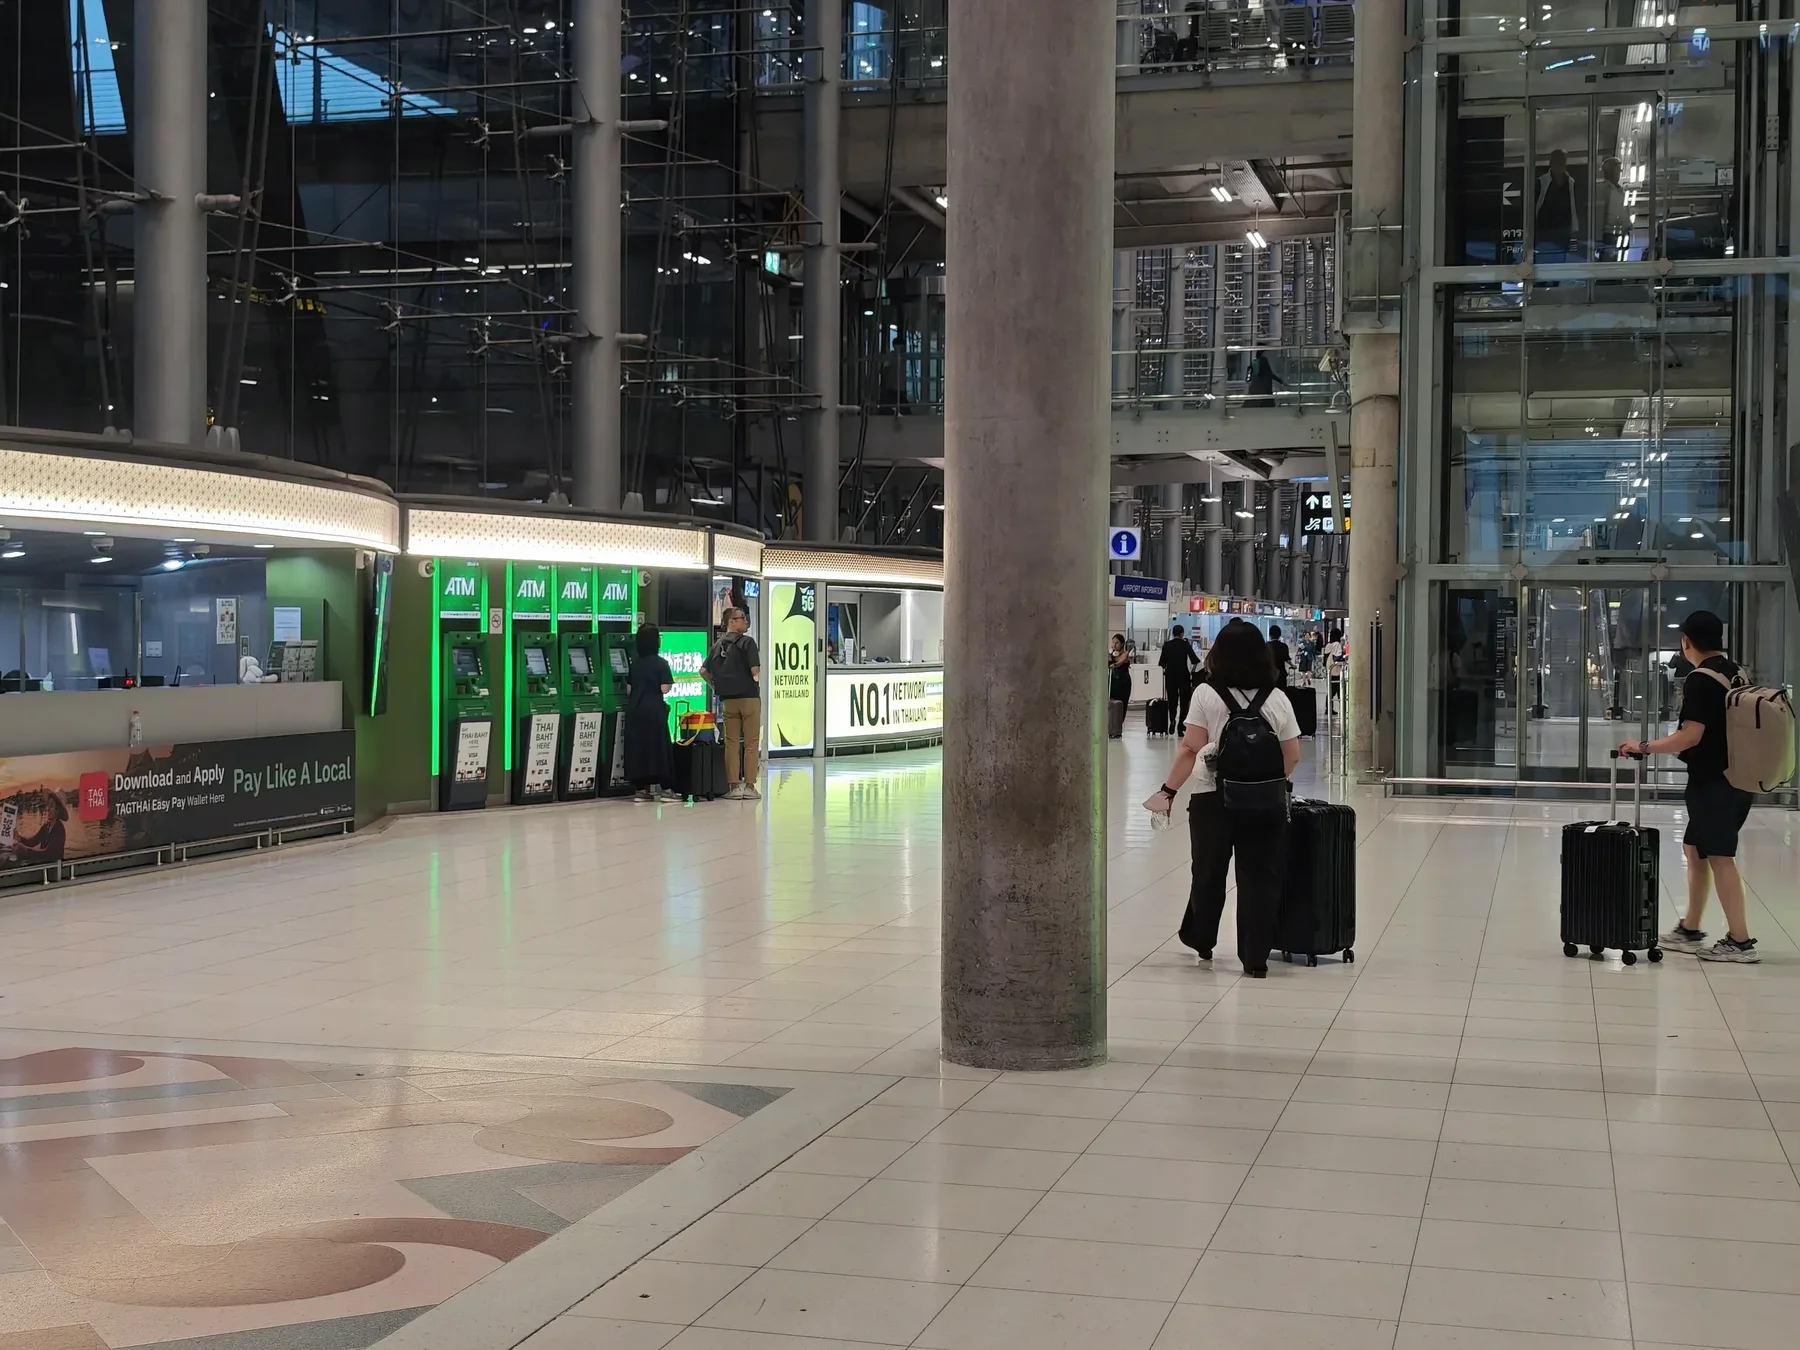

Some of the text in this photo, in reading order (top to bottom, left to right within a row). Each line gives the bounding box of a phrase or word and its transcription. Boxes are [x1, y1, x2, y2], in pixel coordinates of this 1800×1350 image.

[444, 577, 475, 596] ATM
[517, 580, 545, 598] ATM
[561, 581, 587, 599] ATM
[602, 583, 628, 601] ATM
[1122, 584, 1164, 595] AIRPORT INFORMATION
[801, 595, 815, 612] 5G
[775, 642, 810, 671] NO.1
[774, 675, 809, 686] NETWORK
[774, 689, 810, 699] IN THAILAND
[892, 681, 926, 700] NETWORK
[850, 682, 890, 727] NO.1
[892, 709, 900, 724] IN
[901, 706, 927, 723] THAILAND
[536, 723, 554, 732] THAI
[580, 721, 597, 730] THAI
[461, 732, 474, 740] THAI
[536, 733, 554, 741] BAHT
[580, 731, 596, 740] BAHT
[537, 742, 551, 750] HERE
[115, 763, 225, 792] Download and Apply
[233, 756, 351, 798] Pay Like A Local
[88, 788, 103, 799] TAG
[115, 793, 225, 816] TAGTHAi Easy Pay Wallet Here
